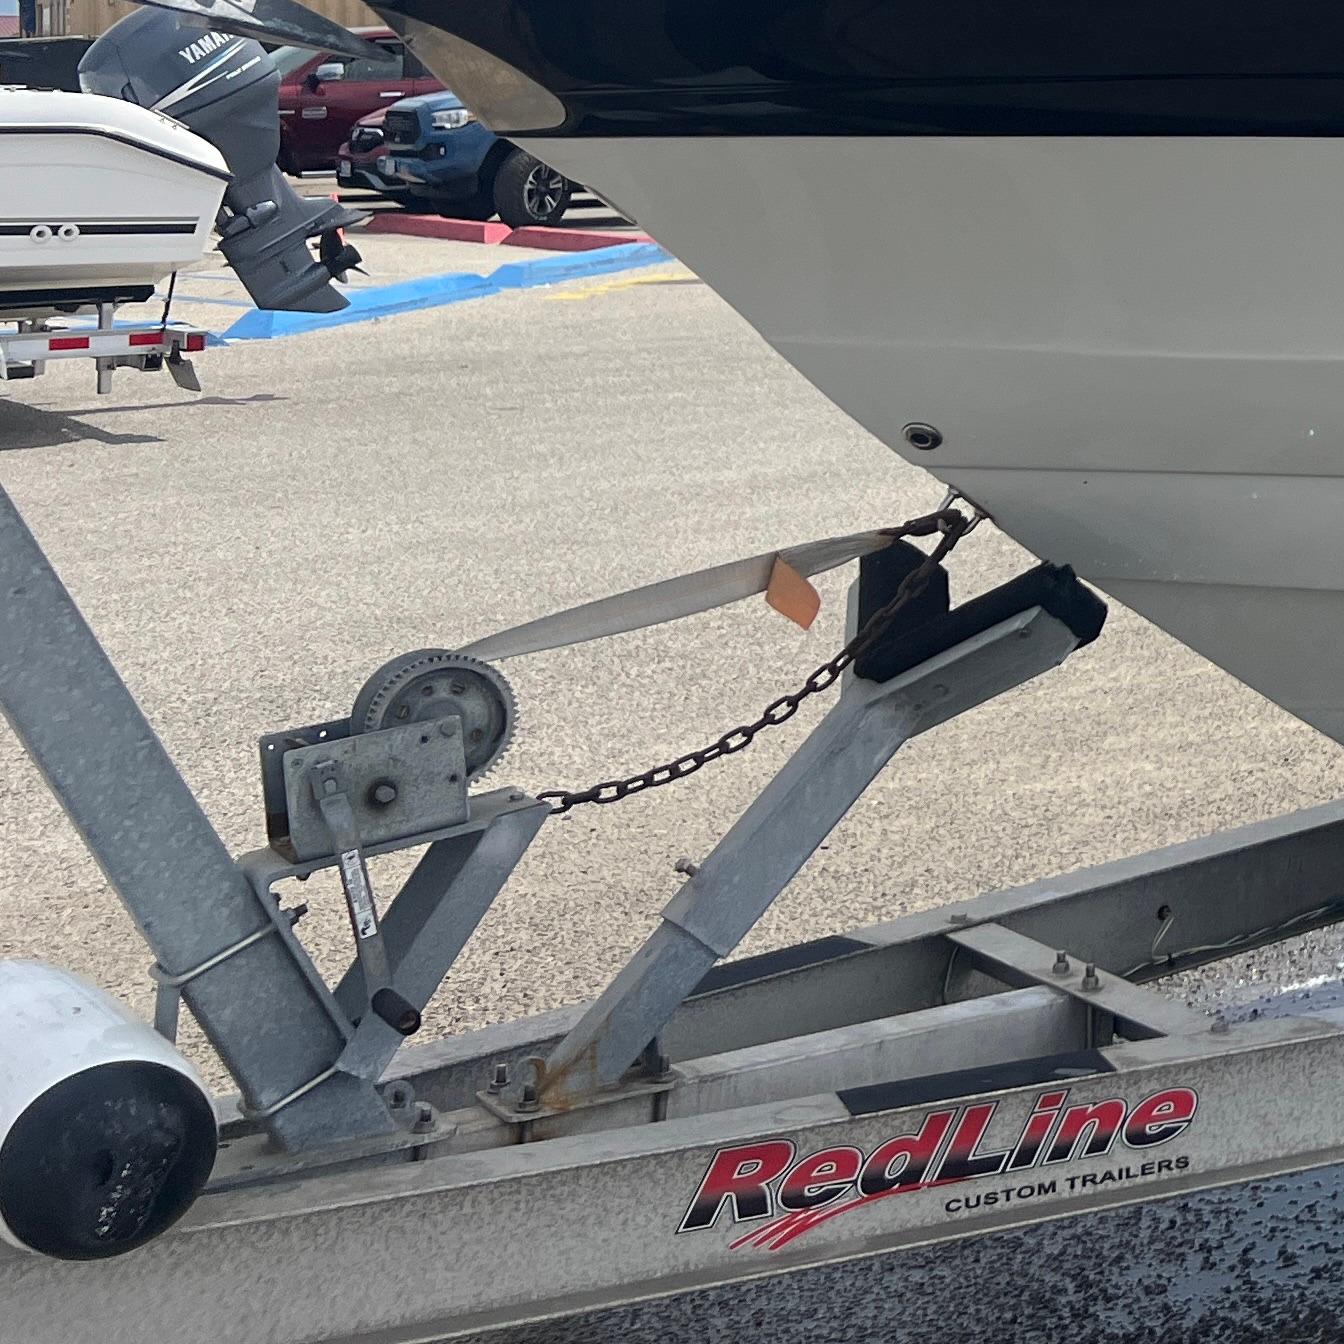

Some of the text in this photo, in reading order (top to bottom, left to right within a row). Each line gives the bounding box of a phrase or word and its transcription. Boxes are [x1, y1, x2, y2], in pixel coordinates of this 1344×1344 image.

[178, 31, 235, 64] YAMA
[675, 1087, 1200, 1234] RedLine
[944, 1156, 1190, 1213] CUSTOM TRAILERS
